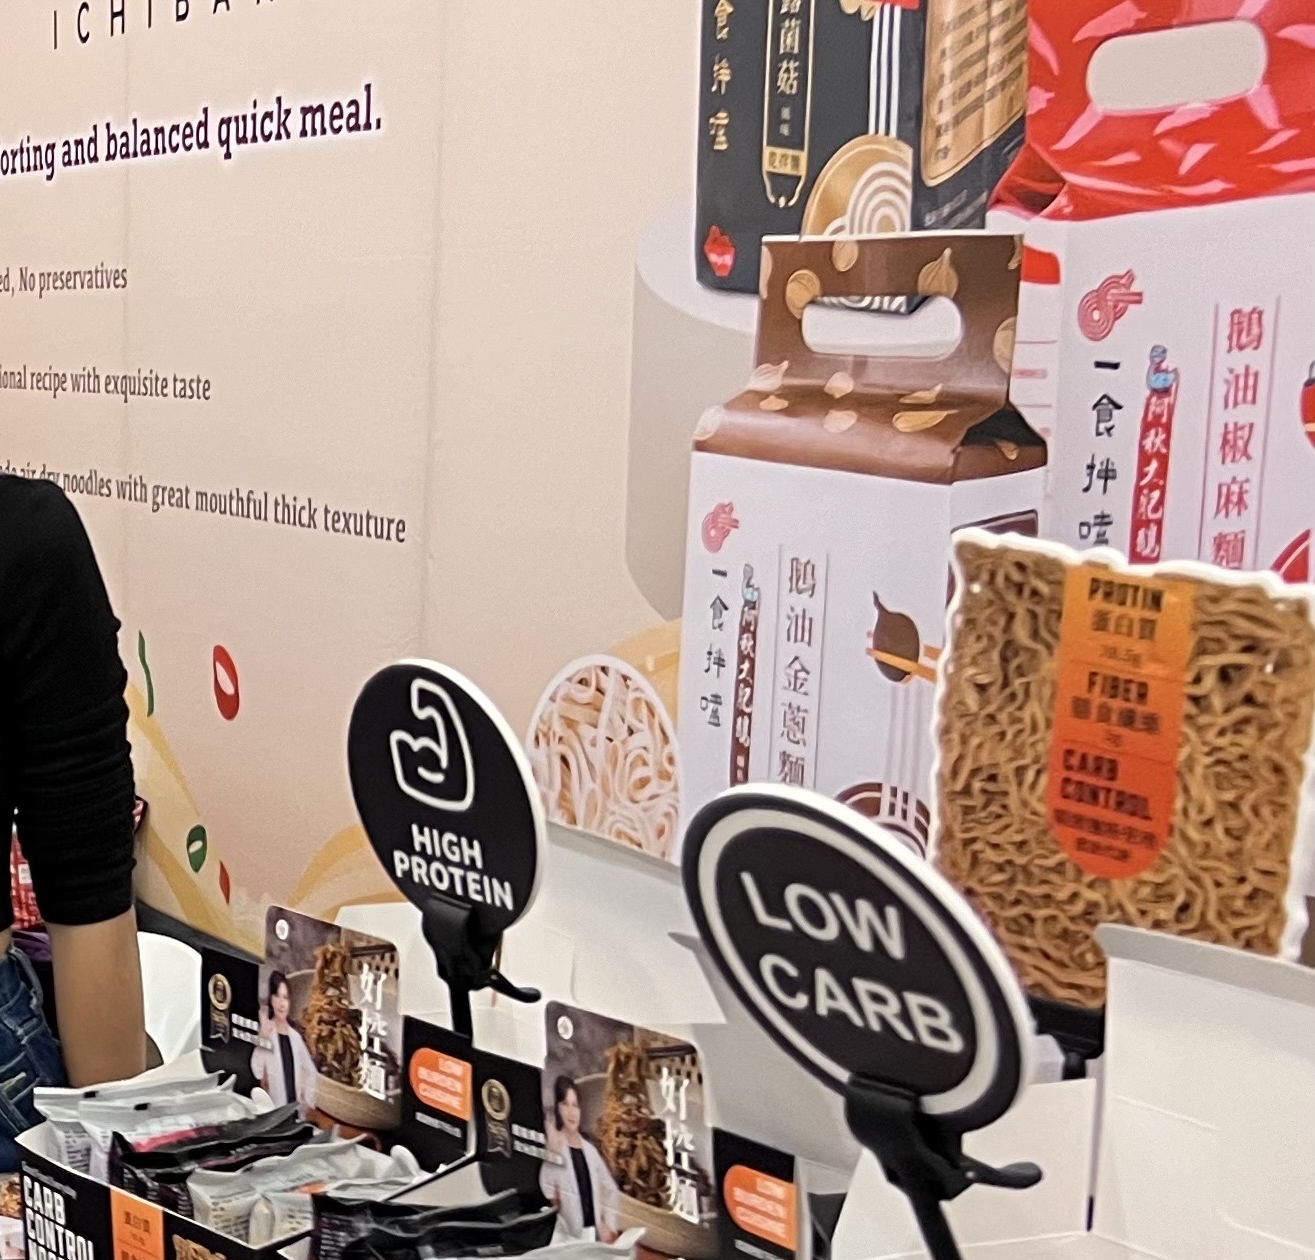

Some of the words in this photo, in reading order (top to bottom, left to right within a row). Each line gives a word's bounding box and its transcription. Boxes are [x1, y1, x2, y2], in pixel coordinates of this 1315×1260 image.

[62, 124, 99, 166] and
[105, 106, 210, 162] balanced
[217, 96, 292, 160] quick
[299, 83, 382, 138] meal.
[19, 267, 36, 292] No
[39, 262, 128, 299] preservatives
[30, 365, 67, 399] recipe
[70, 366, 101, 394] with
[105, 368, 169, 404] exquisite
[173, 373, 211, 400] taste
[63, 469, 112, 497] noodles
[116, 475, 148, 503] with
[152, 482, 190, 512] great
[195, 489, 269, 522] mouthful
[273, 493, 317, 530] thick
[323, 504, 406, 543] texuture
[1088, 671, 1148, 705] FIBER
[411, 823, 483, 870] HIGH
[393, 849, 513, 911] PROTEIN
[740, 871, 905, 960] LOW
[759, 953, 964, 1053] CARB
[23, 1175, 66, 1226] CARB
